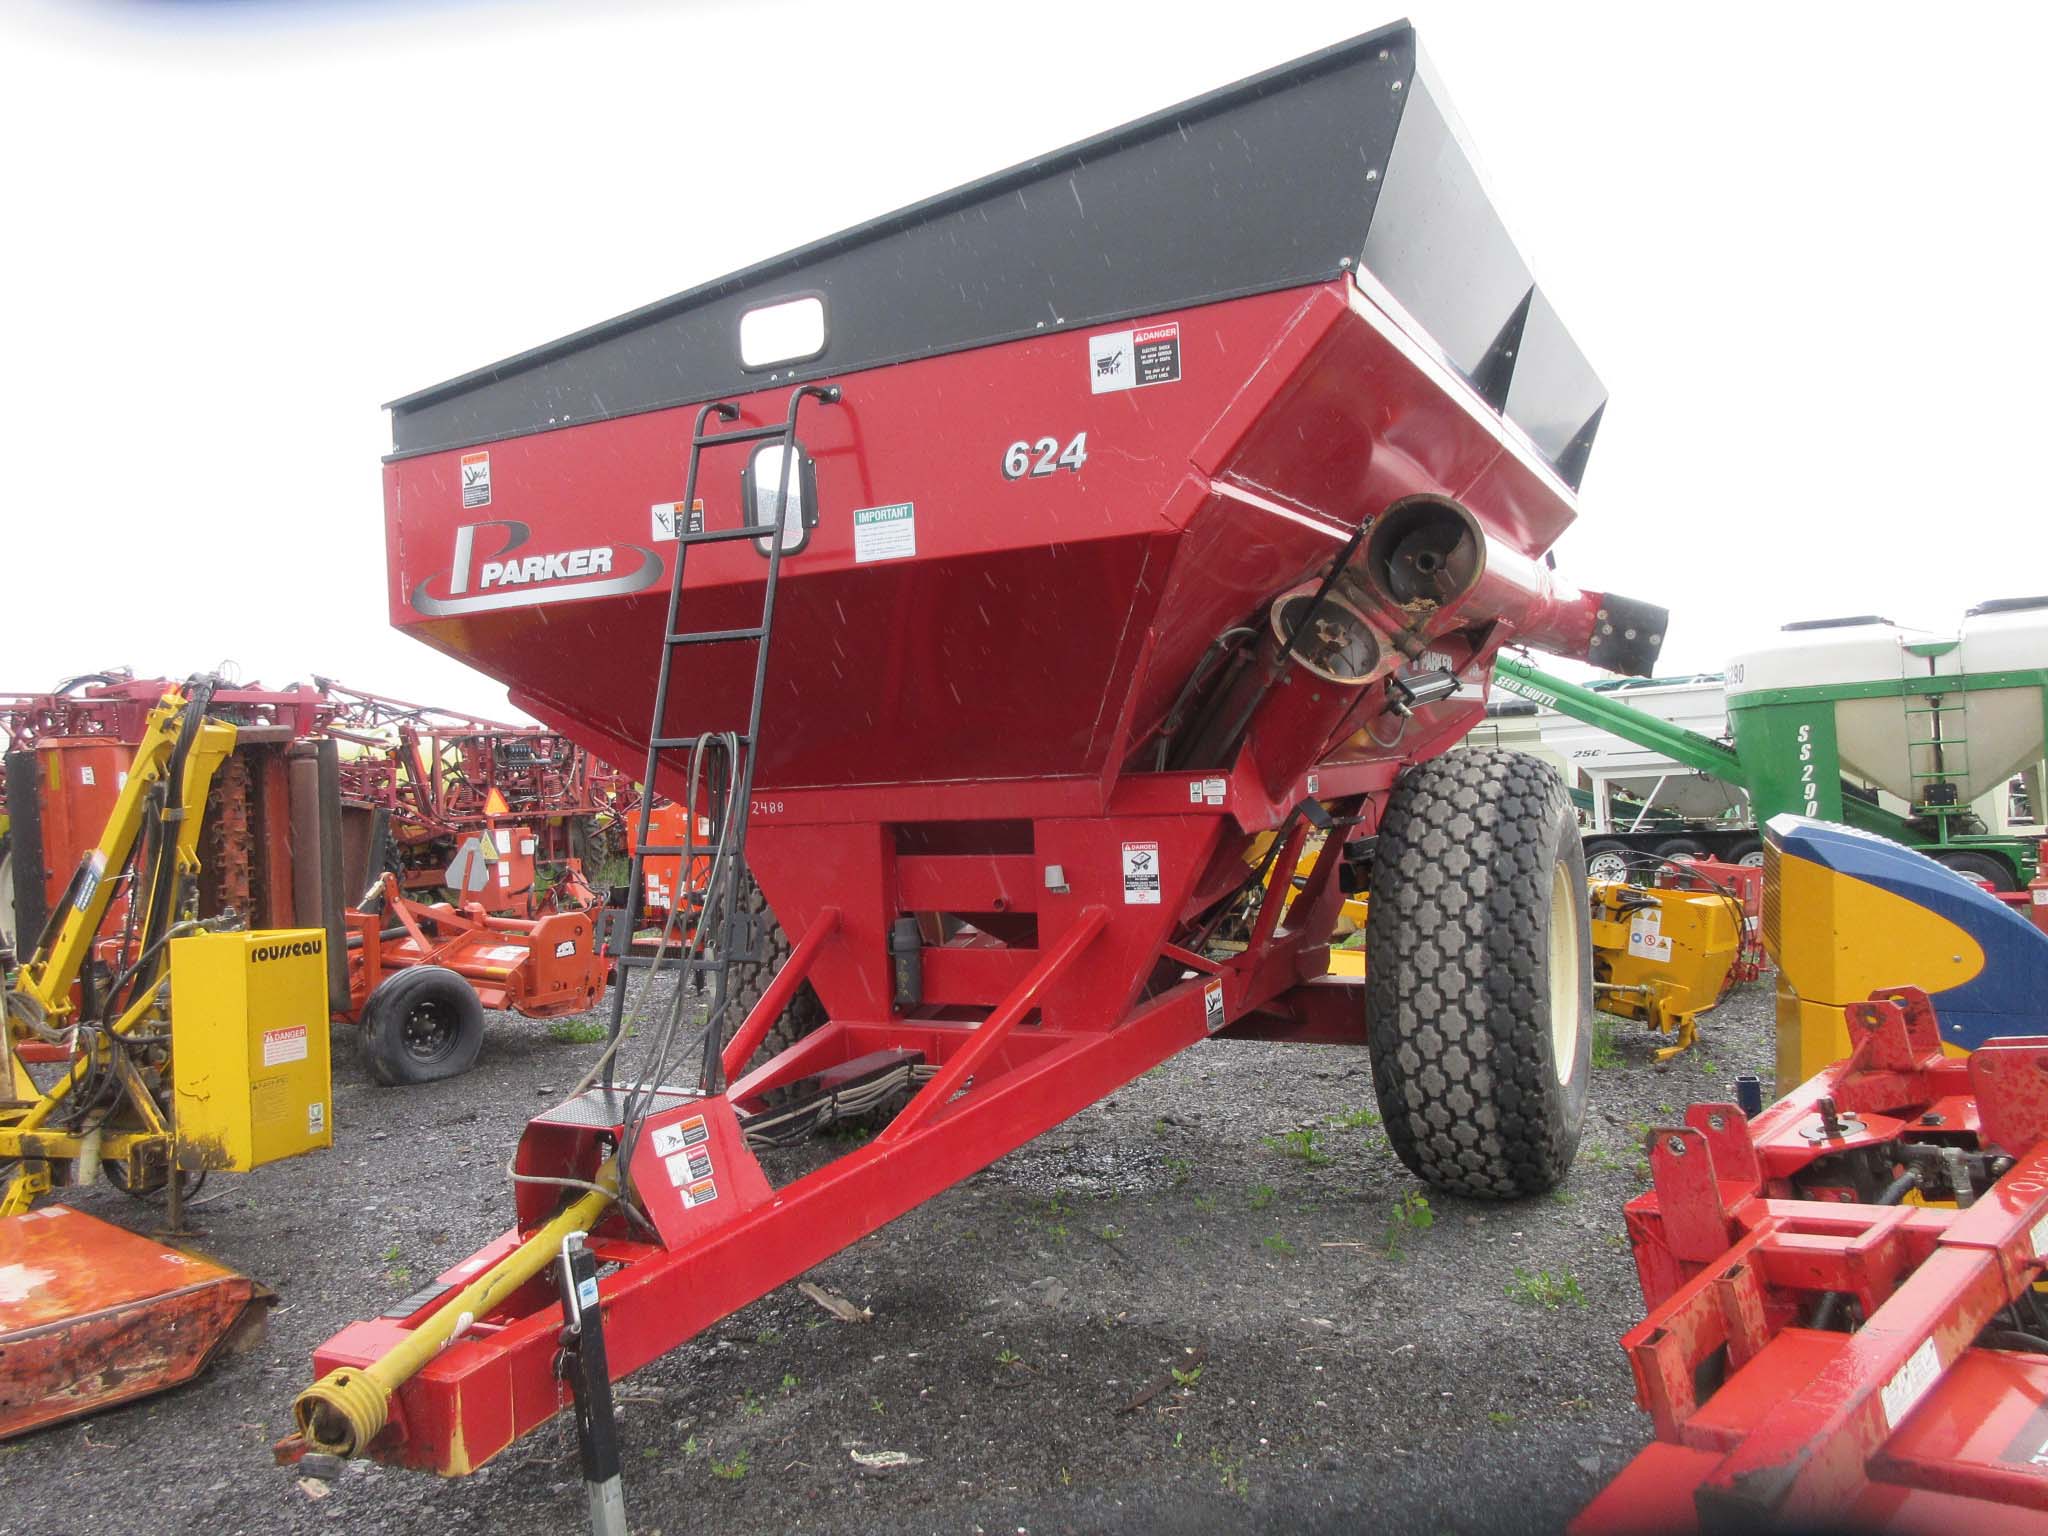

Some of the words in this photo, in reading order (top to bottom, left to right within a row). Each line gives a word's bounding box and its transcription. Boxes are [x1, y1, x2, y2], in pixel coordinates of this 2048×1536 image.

[1143, 328, 1176, 340] DANGER
[1001, 431, 1088, 481] 624
[858, 506, 909, 524] IMPORTANT
[479, 546, 614, 590] PARKER
[1495, 675, 1520, 692] SEED
[274, 1028, 306, 1041] DANGER
